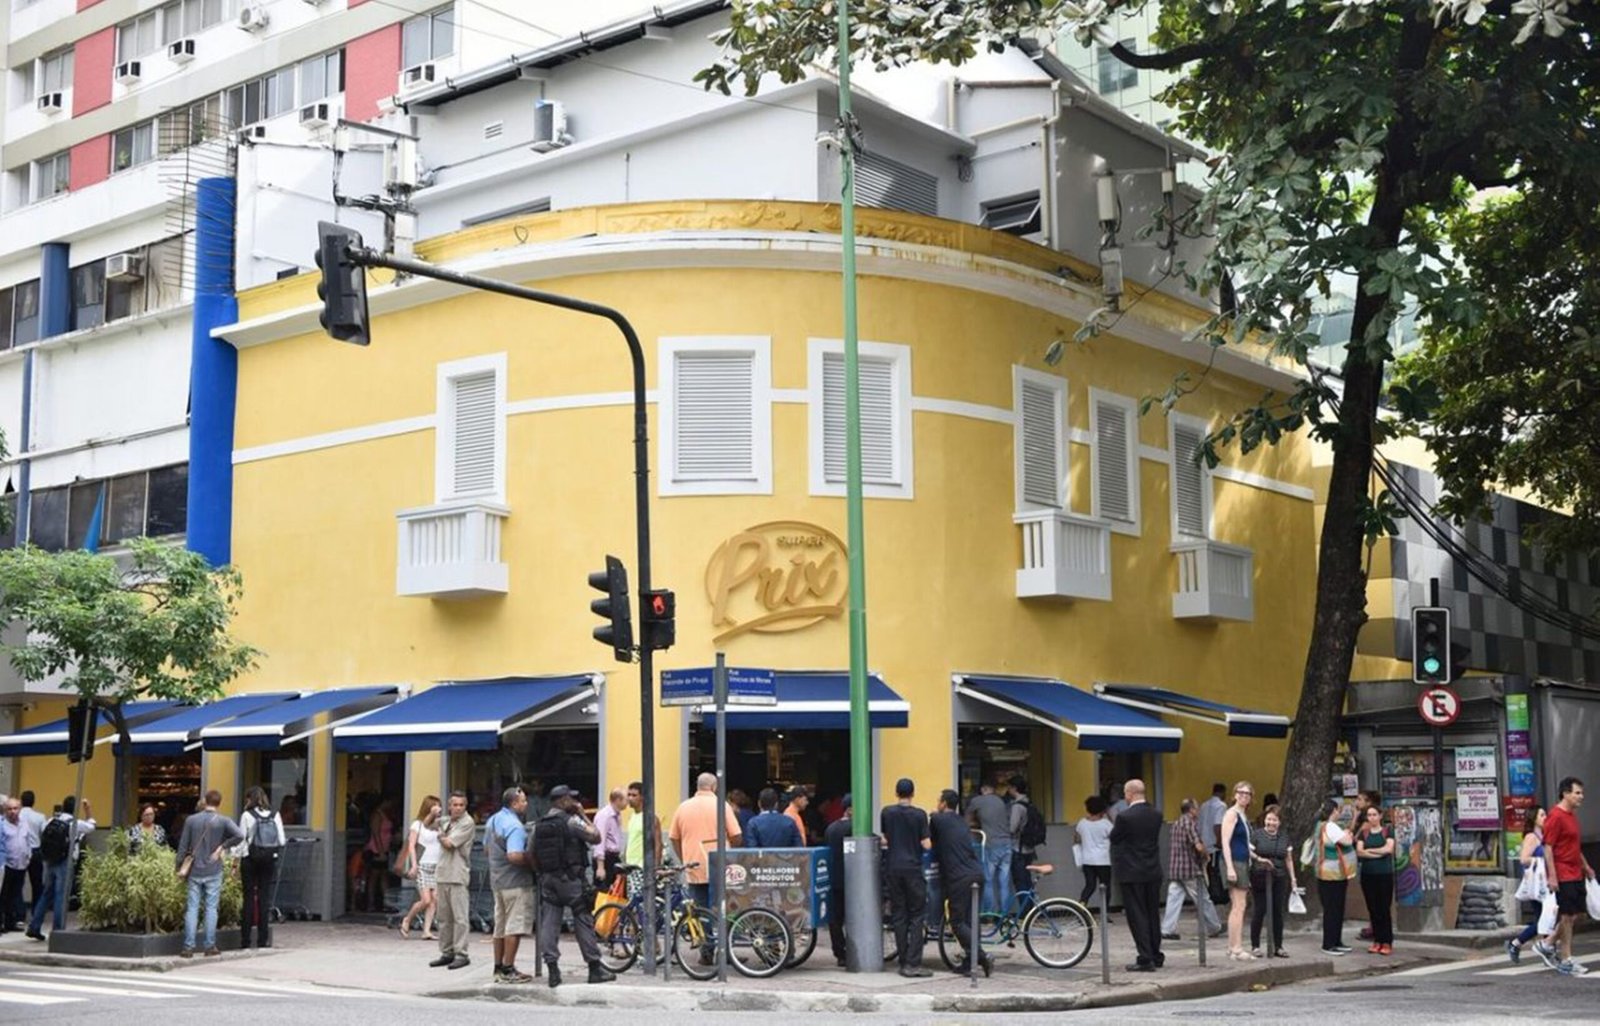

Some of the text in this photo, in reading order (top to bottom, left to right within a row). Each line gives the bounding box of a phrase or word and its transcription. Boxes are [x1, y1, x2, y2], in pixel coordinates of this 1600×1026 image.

[776, 536, 825, 547] SUPER
[712, 532, 839, 628] Prix
[1458, 760, 1476, 771] MB
